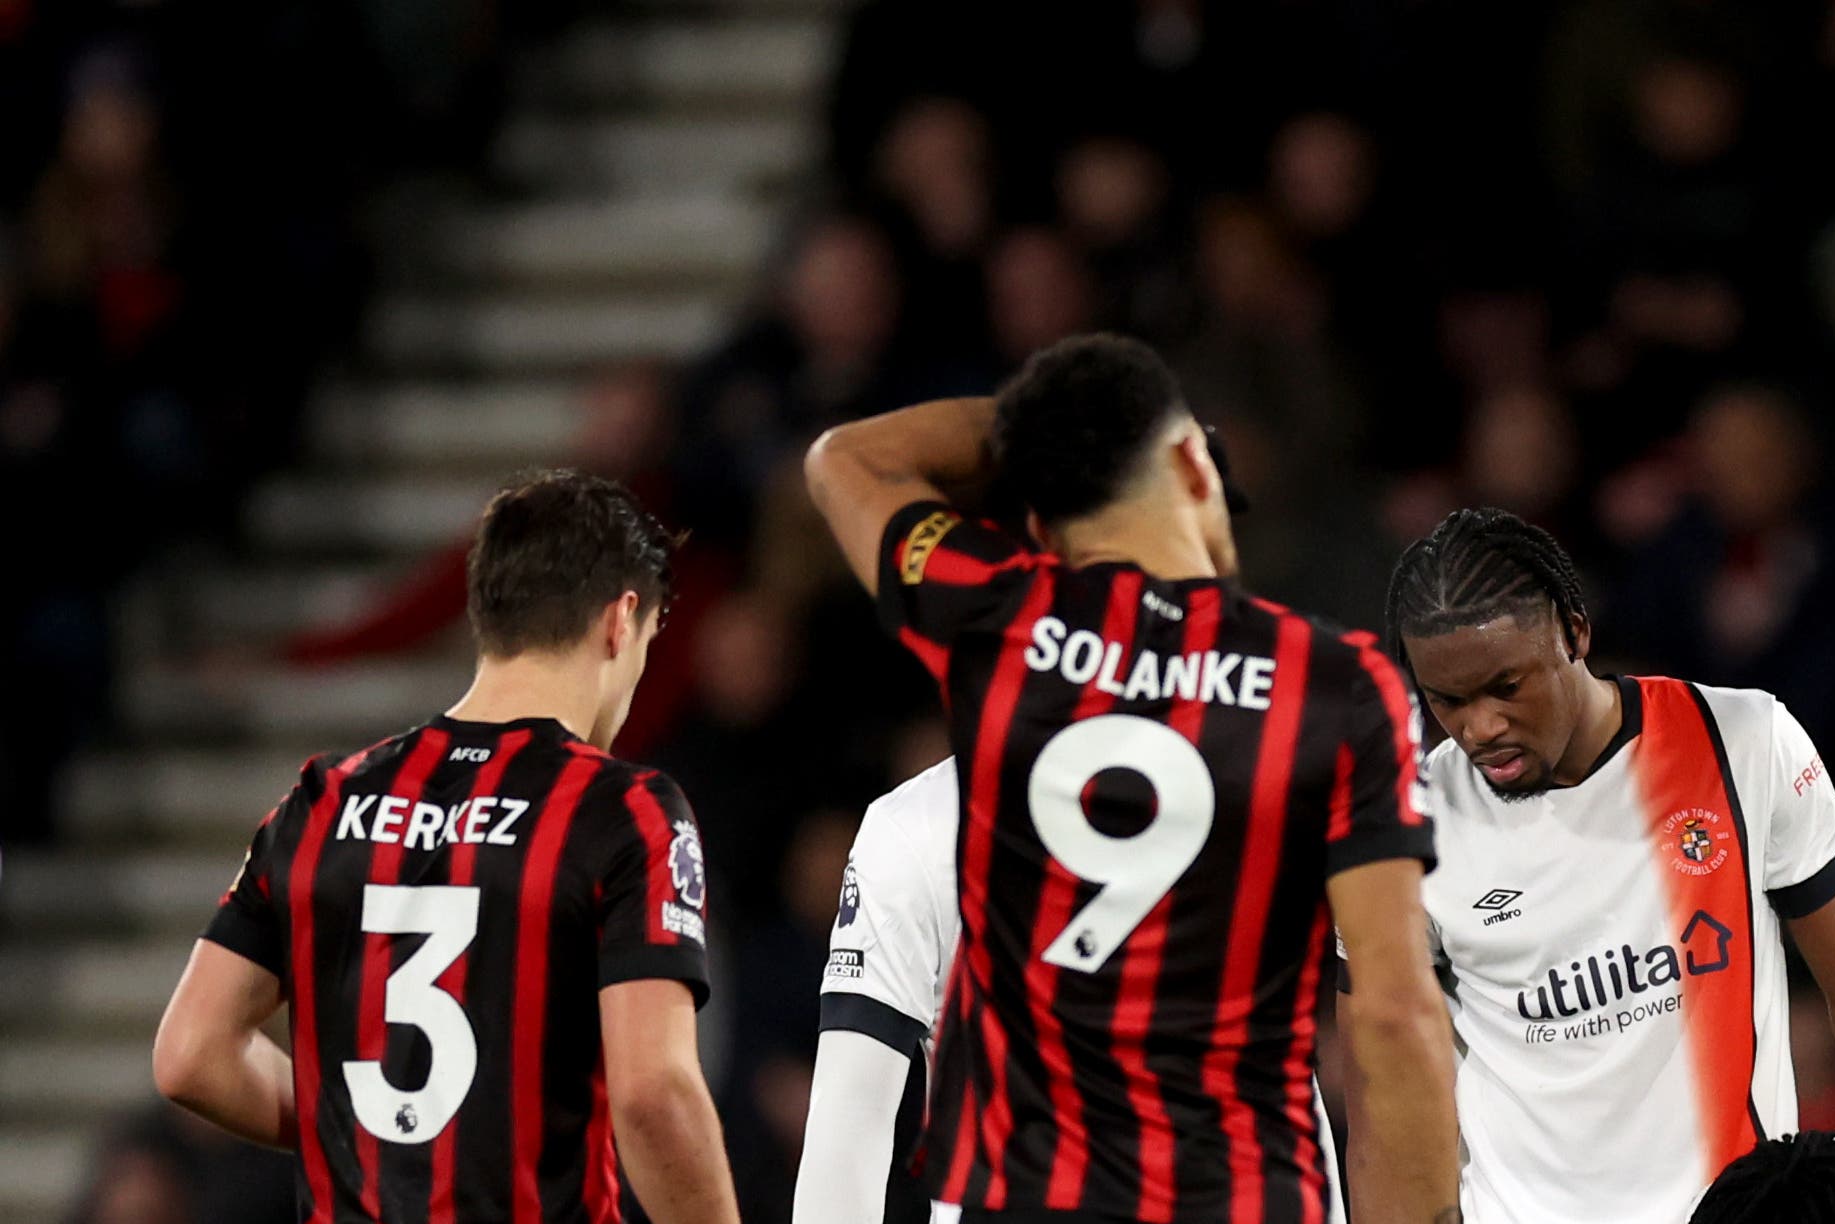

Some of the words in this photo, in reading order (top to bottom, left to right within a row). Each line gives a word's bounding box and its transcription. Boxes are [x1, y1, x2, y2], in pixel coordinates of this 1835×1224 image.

[1024, 616, 1277, 710] SOLANKE
[449, 747, 491, 762] AFCB
[336, 794, 530, 851] KERKEZ
[1028, 714, 1215, 973] 9
[1483, 909, 1521, 926] umbro
[342, 884, 480, 1144] 3
[1518, 944, 1681, 1020] utilita
[1525, 1024, 1557, 1044] life
[1564, 1013, 1611, 1040] with
[1616, 993, 1683, 1033] power
